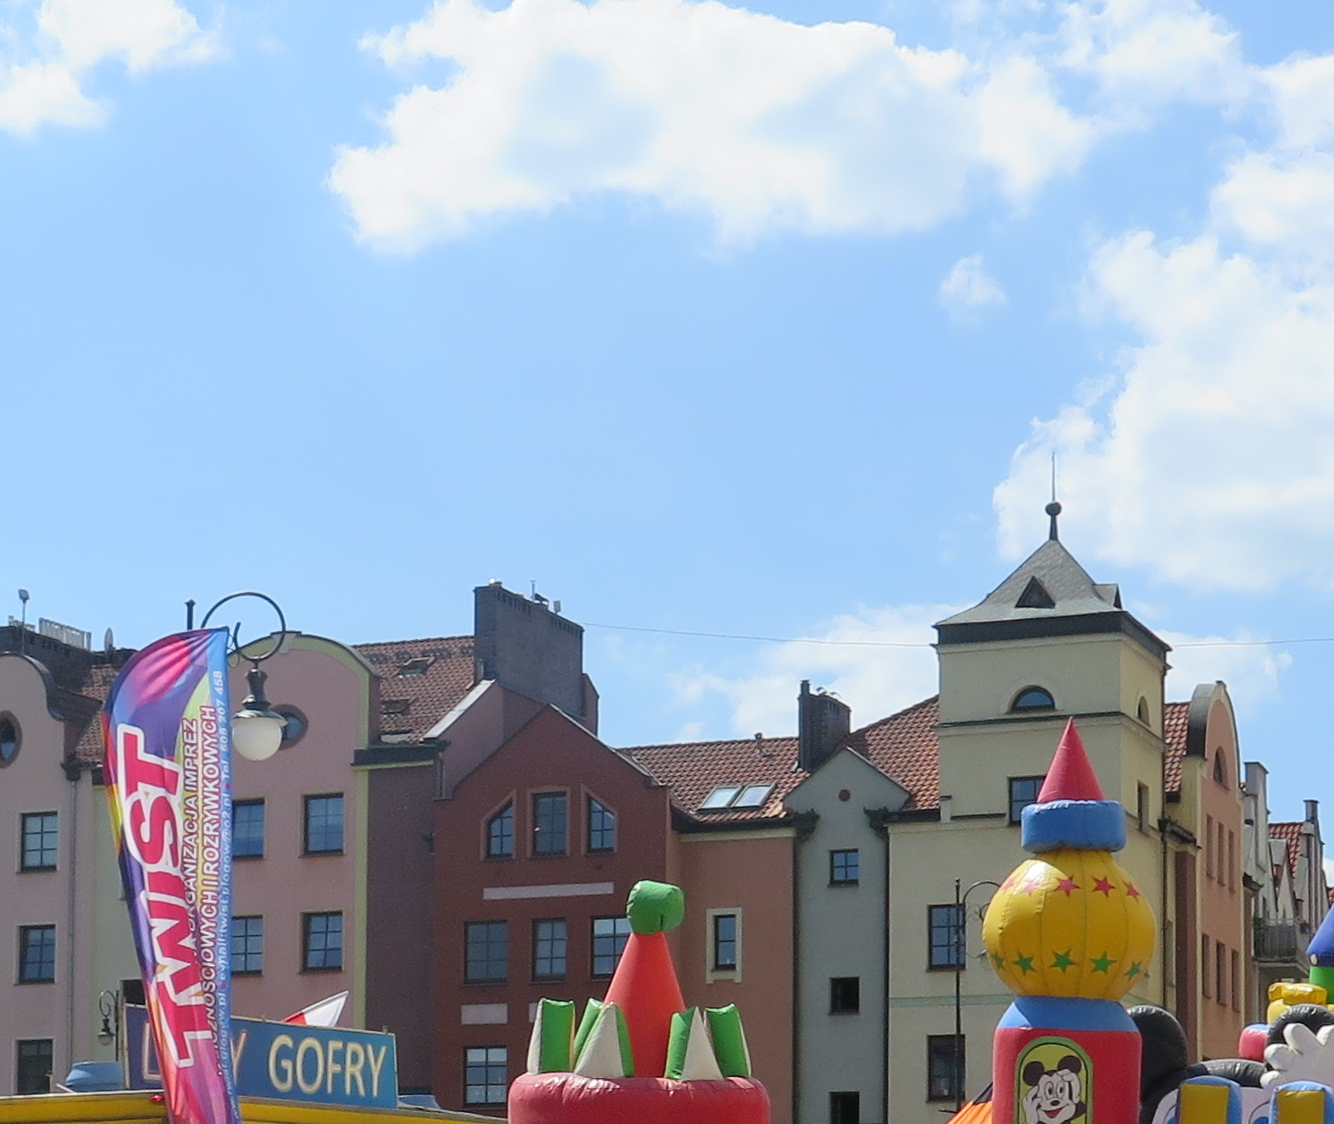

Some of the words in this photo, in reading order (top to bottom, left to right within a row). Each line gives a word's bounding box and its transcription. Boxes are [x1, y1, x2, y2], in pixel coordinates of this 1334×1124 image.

[212, 670, 224, 695] 458
[182, 719, 198, 792] IMPREZ
[200, 706, 220, 875] ROZRYWKOWYCH
[142, 1021, 247, 1088] LY
[267, 1034, 387, 1097] GOFRY
